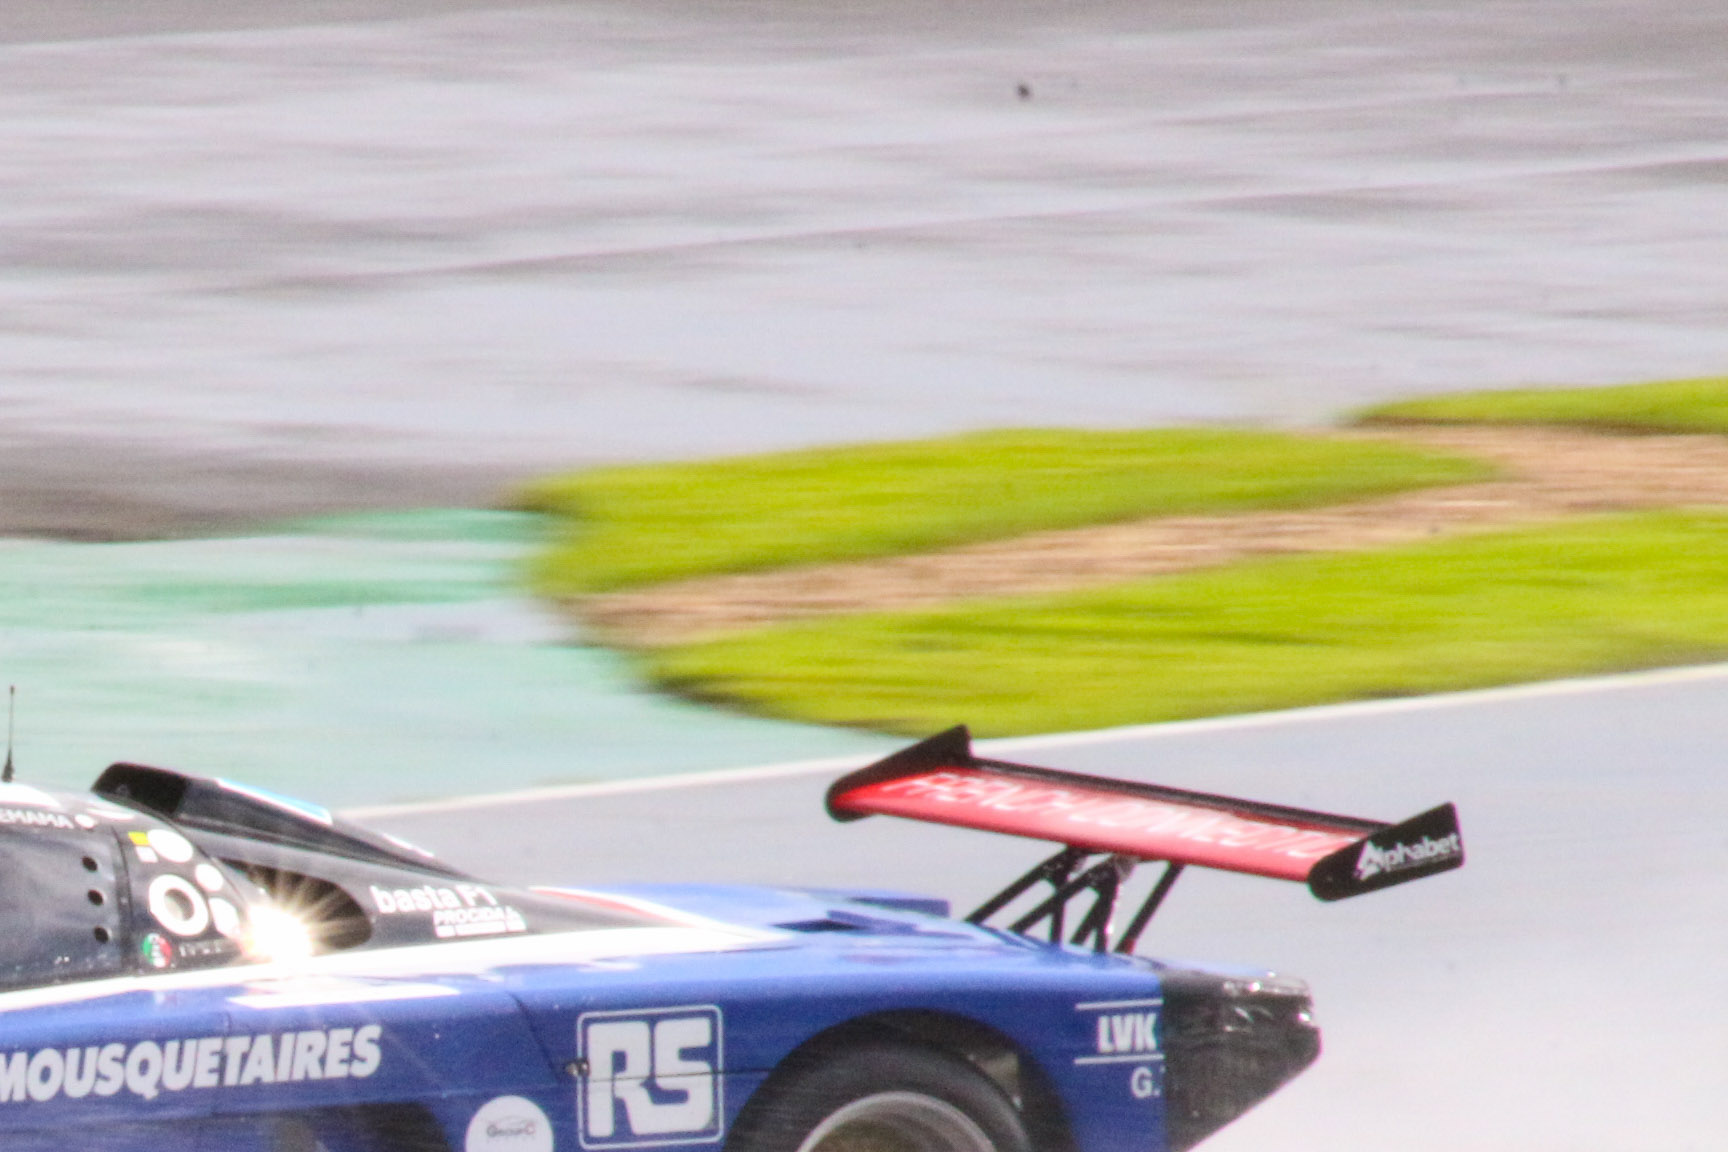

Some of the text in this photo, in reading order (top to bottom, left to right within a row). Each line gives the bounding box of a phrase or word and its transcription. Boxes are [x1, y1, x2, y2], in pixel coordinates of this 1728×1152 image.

[1356, 834, 1459, 880] Alphabet
[369, 884, 461, 914] basta
[1097, 1012, 1157, 1053] LVK
[586, 1016, 716, 1139] RS
